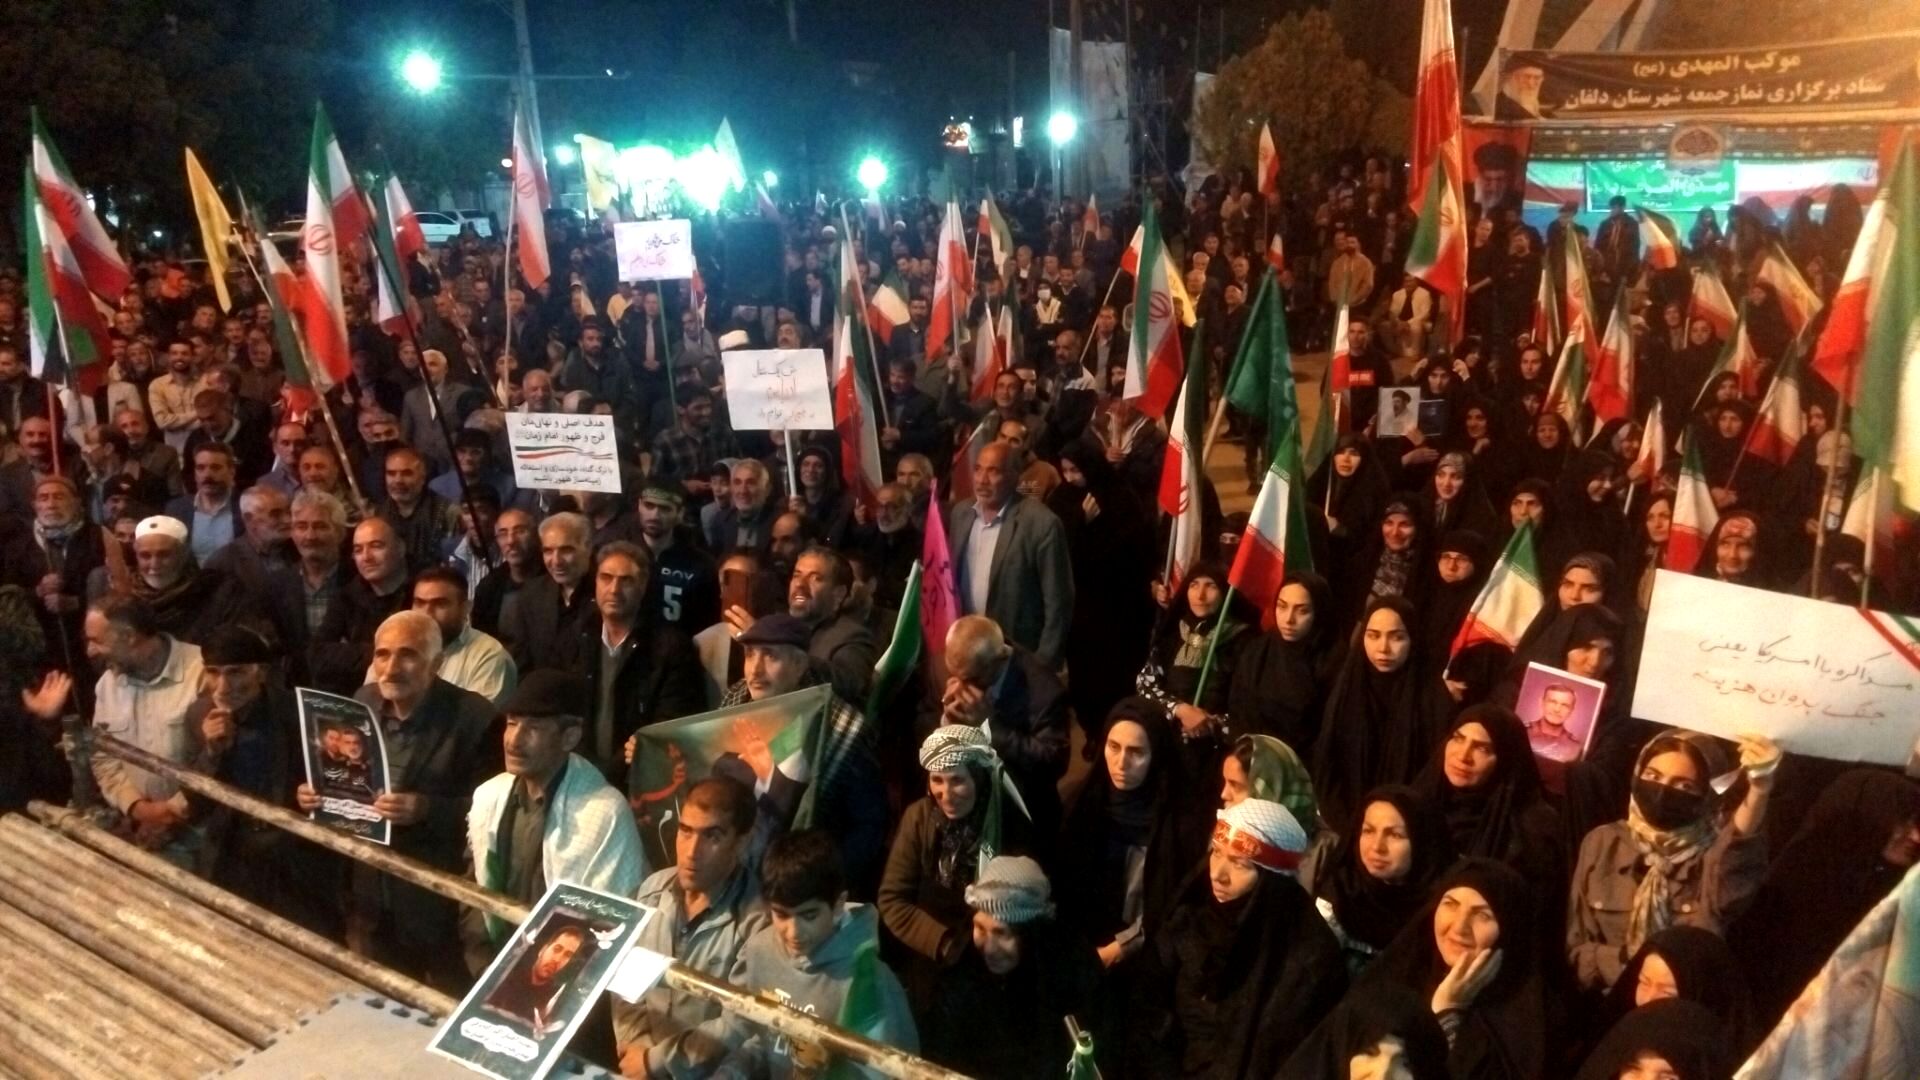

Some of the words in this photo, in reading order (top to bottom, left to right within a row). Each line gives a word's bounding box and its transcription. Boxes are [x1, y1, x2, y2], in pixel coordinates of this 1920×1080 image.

[1670, 55, 1739, 77] المهدی
[1744, 51, 1800, 73] موکب
[1731, 83, 1763, 104] نماز
[1846, 77, 1886, 94] ستاد
[1565, 88, 1609, 109] دلفان
[1612, 87, 1682, 108] شهرستان
[1687, 90, 1729, 104] جمعه
[554, 420, 559, 428] و
[561, 418, 581, 429] اصلی
[583, 418, 605, 428] هدف
[524, 430, 542, 441] زمان
[543, 432, 559, 442] امام
[561, 431, 582, 442] ظهور
[584, 434, 589, 442] و
[591, 433, 605, 445] فرج
[663, 584, 683, 621] 5
[1698, 636, 1747, 660] یعنی
[1820, 659, 1832, 677] با
[1831, 651, 1913, 691] مذاکره
[1693, 671, 1757, 695] هزینه
[1822, 700, 1885, 726] جنگ
